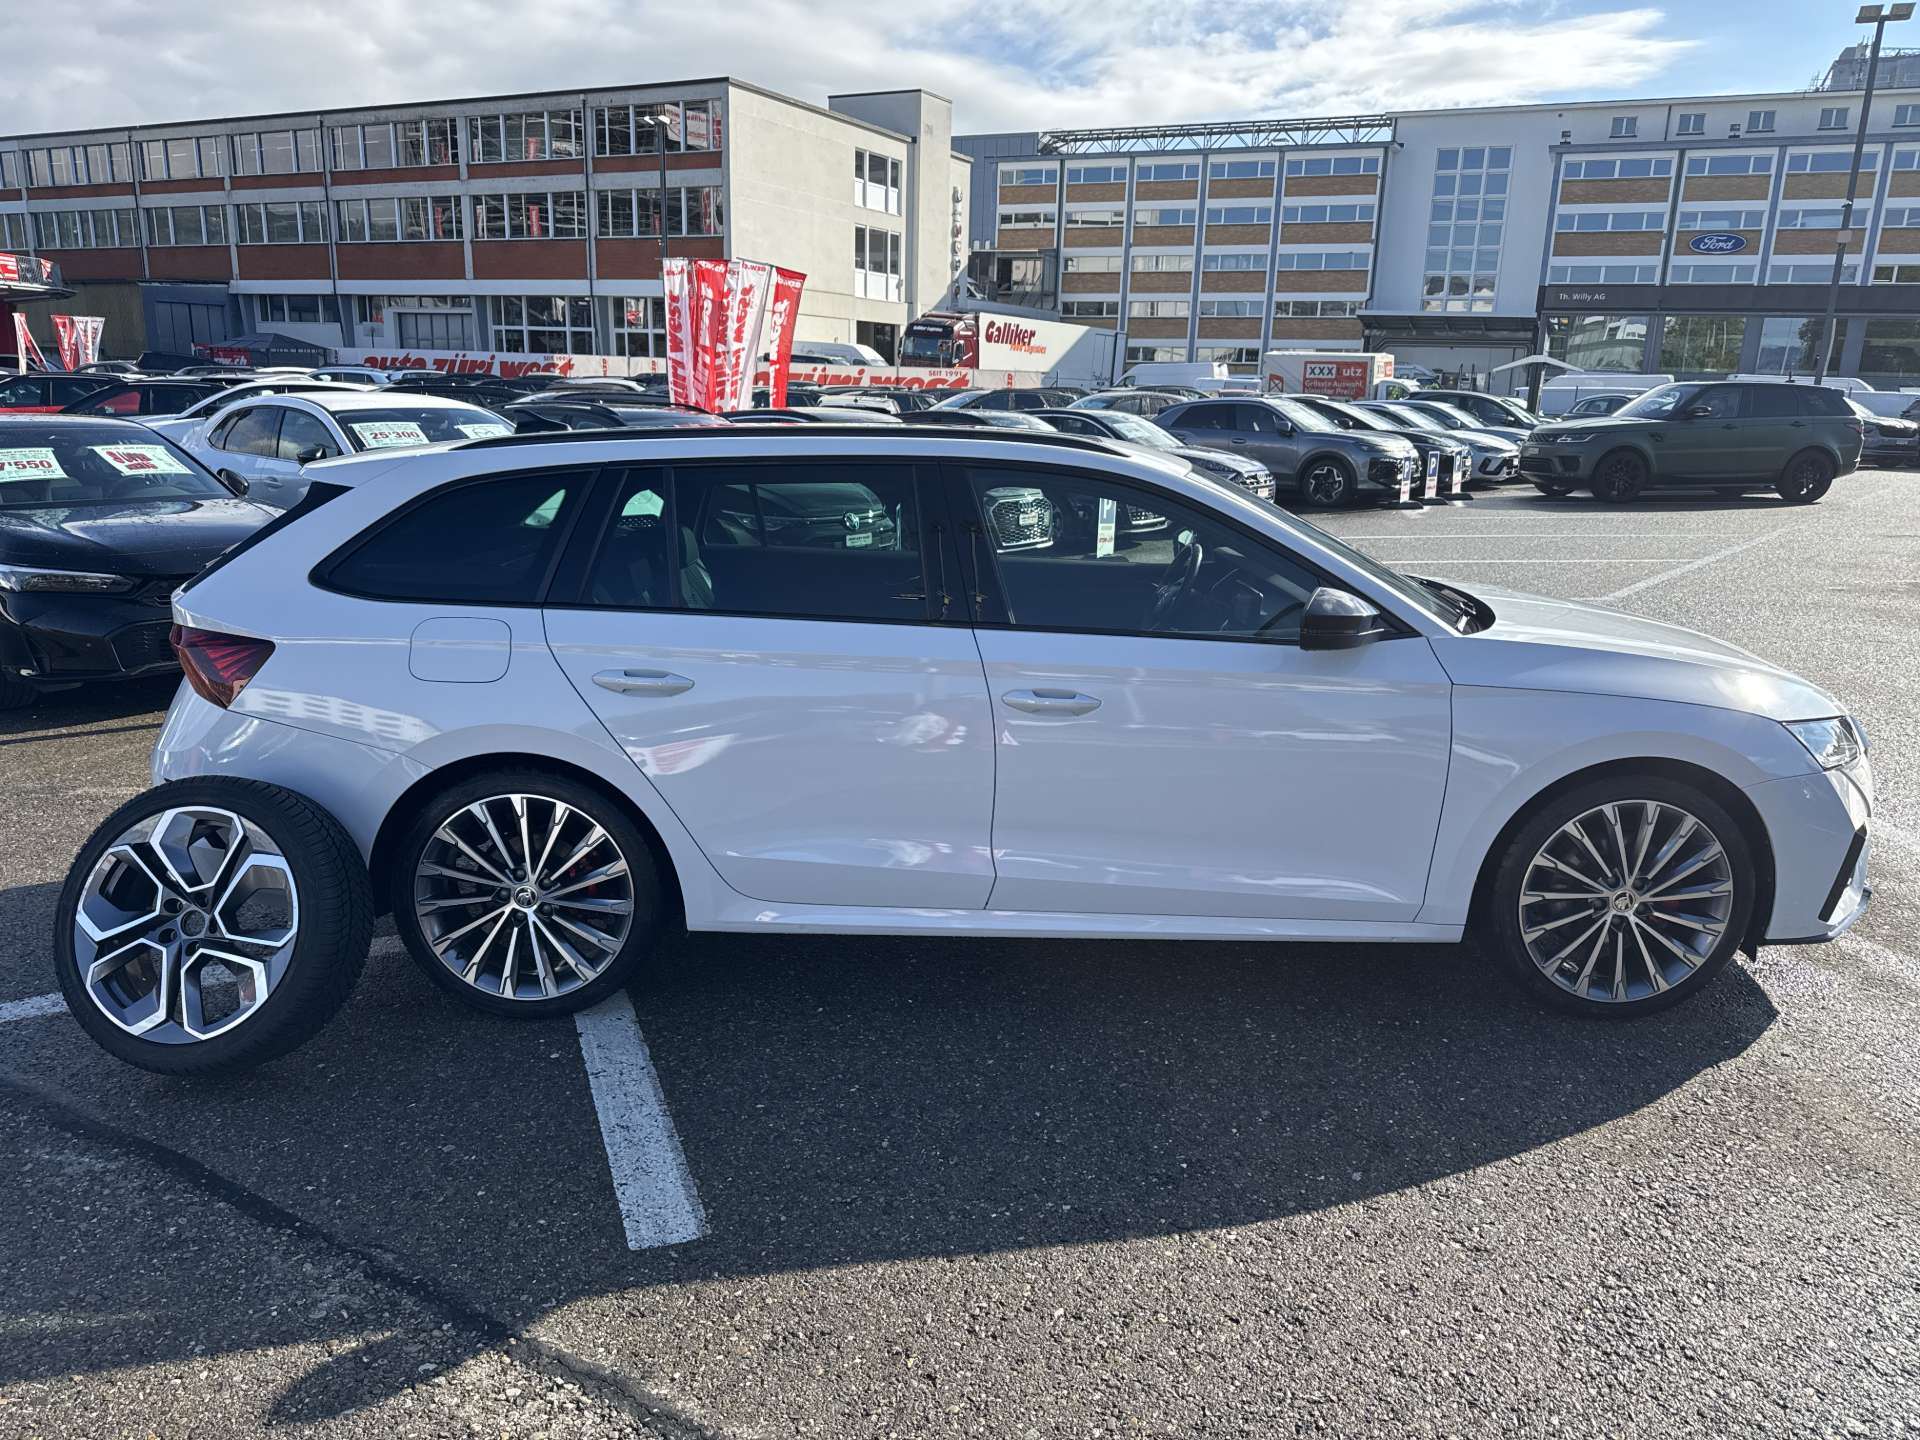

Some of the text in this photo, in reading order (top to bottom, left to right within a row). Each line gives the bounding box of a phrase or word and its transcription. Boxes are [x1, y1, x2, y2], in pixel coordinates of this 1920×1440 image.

[1699, 236, 1735, 249] Ford
[1572, 292, 1593, 302] Willy
[985, 320, 1036, 346] Galliker
[369, 431, 420, 441] 25'300
[1429, 457, 1437, 475] P
